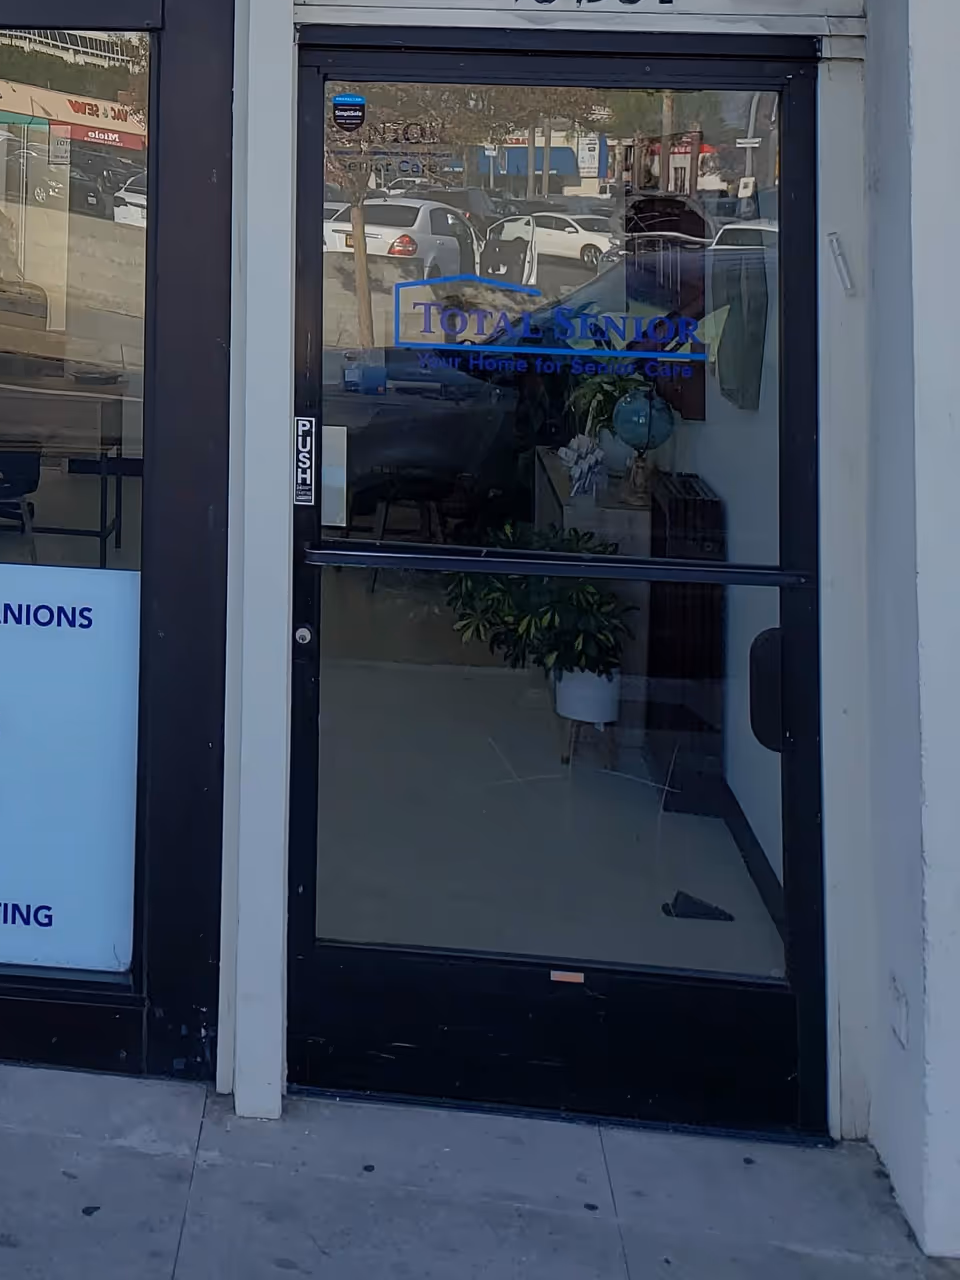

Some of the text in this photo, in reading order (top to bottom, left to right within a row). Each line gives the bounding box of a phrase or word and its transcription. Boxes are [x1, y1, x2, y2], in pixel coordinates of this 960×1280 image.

[413, 301, 705, 345] TOTAL SENIOR
[469, 353, 529, 373] Home
[535, 356, 562, 375] for
[570, 358, 635, 377] Senior
[643, 360, 694, 379] Care
[297, 420, 312, 485] PUSH
